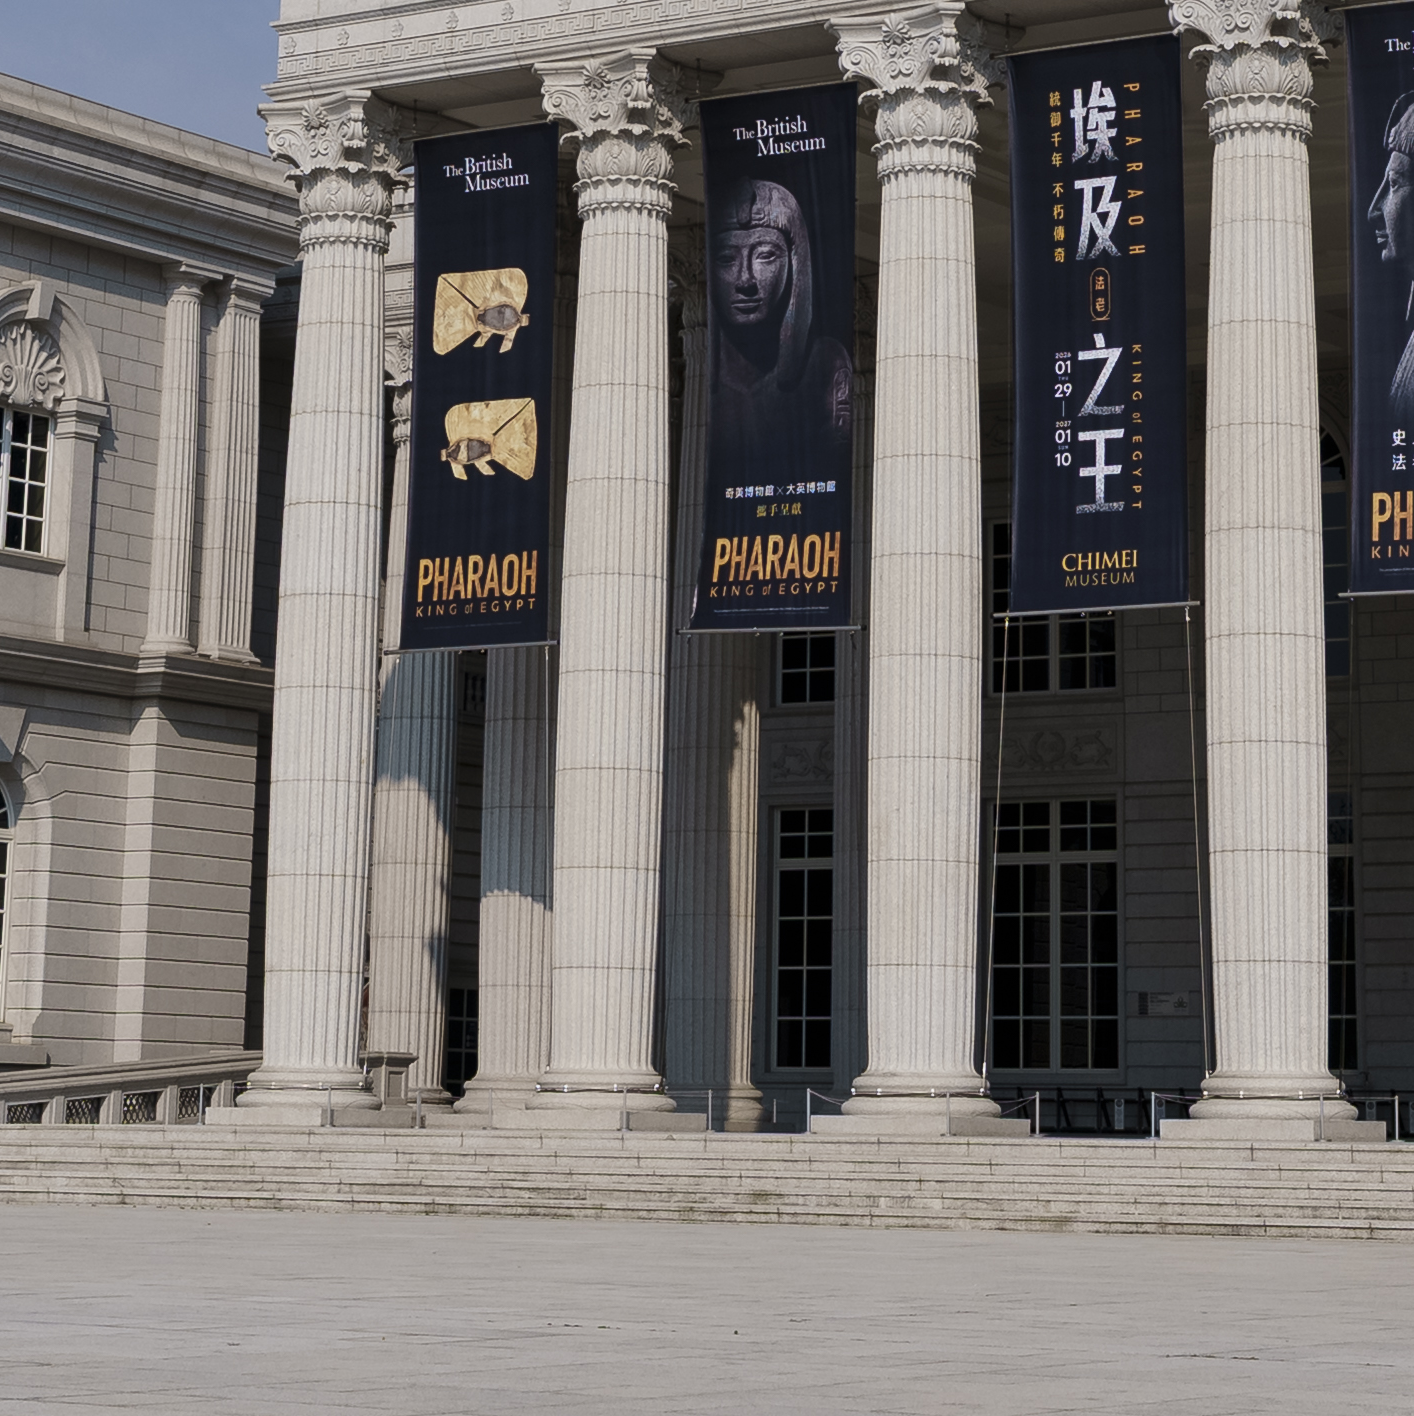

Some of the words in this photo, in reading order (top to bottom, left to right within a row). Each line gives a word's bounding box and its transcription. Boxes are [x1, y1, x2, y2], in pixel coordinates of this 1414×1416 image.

[1384, 37, 1411, 52] The
[732, 127, 756, 141] The
[755, 114, 808, 138] British
[756, 136, 826, 157] Museum
[443, 164, 464, 178] The
[464, 152, 513, 175] British
[1123, 82, 1146, 256] PHARAOH
[464, 173, 530, 193] Museum
[1052, 182, 1065, 264] 不朽傳奇
[1055, 360, 1072, 375] 01
[1131, 344, 1143, 401] KING
[1054, 382, 1073, 398] 29
[1132, 412, 1143, 423] of
[1055, 429, 1072, 443] 01
[1054, 452, 1072, 467] 10
[1132, 435, 1143, 510] EGYPT
[712, 531, 841, 583] PHARAOH
[1061, 549, 1138, 572] CHIMEI
[417, 549, 538, 603] PHARAOH
[1065, 571, 1135, 587] MUSEUM
[709, 584, 754, 598] KING
[762, 583, 772, 596] of
[779, 581, 838, 595] EGYPT
[415, 604, 457, 618] KING
[464, 602, 473, 614] of
[480, 597, 536, 613] EGYPT
